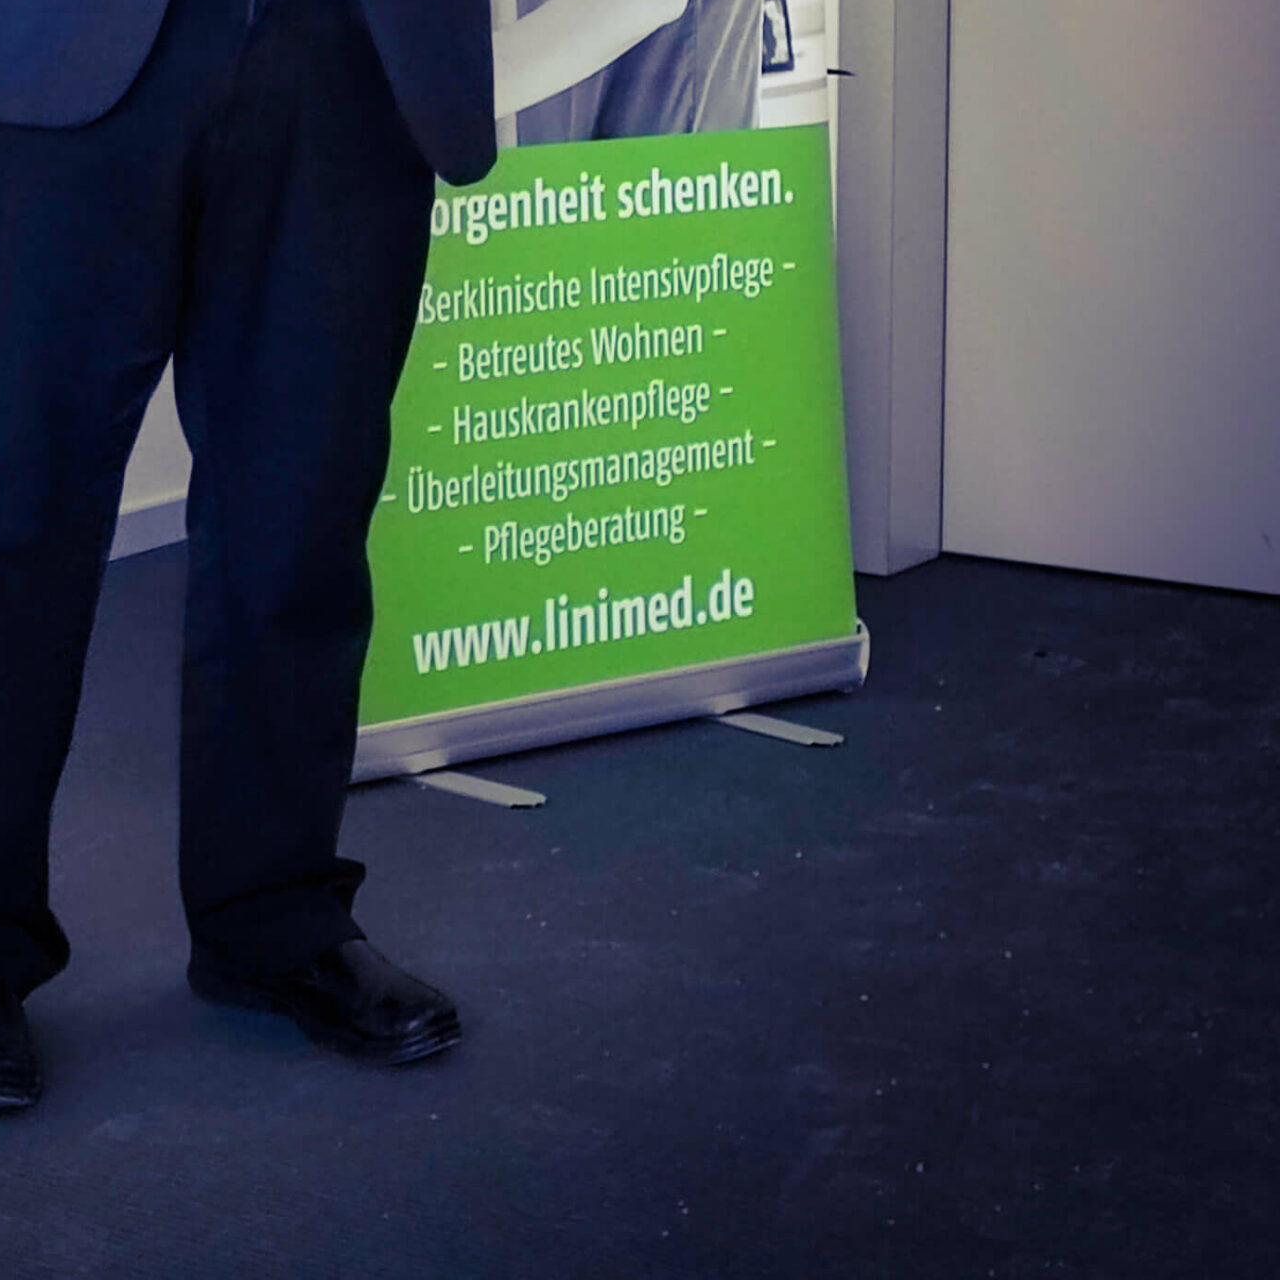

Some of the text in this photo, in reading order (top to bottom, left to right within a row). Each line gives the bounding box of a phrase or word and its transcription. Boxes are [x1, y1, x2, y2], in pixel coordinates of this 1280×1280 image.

[617, 161, 794, 219] schenken.
[591, 253, 774, 305] Intensivpflege
[459, 335, 583, 382] Betreutes
[590, 323, 703, 366] Wohnen
[454, 379, 711, 444] Hauskrankenpflege
[407, 429, 755, 514] Überleitungsmanagement
[484, 504, 685, 565] Pflegeberatung
[412, 568, 755, 674] www.linimed.de
